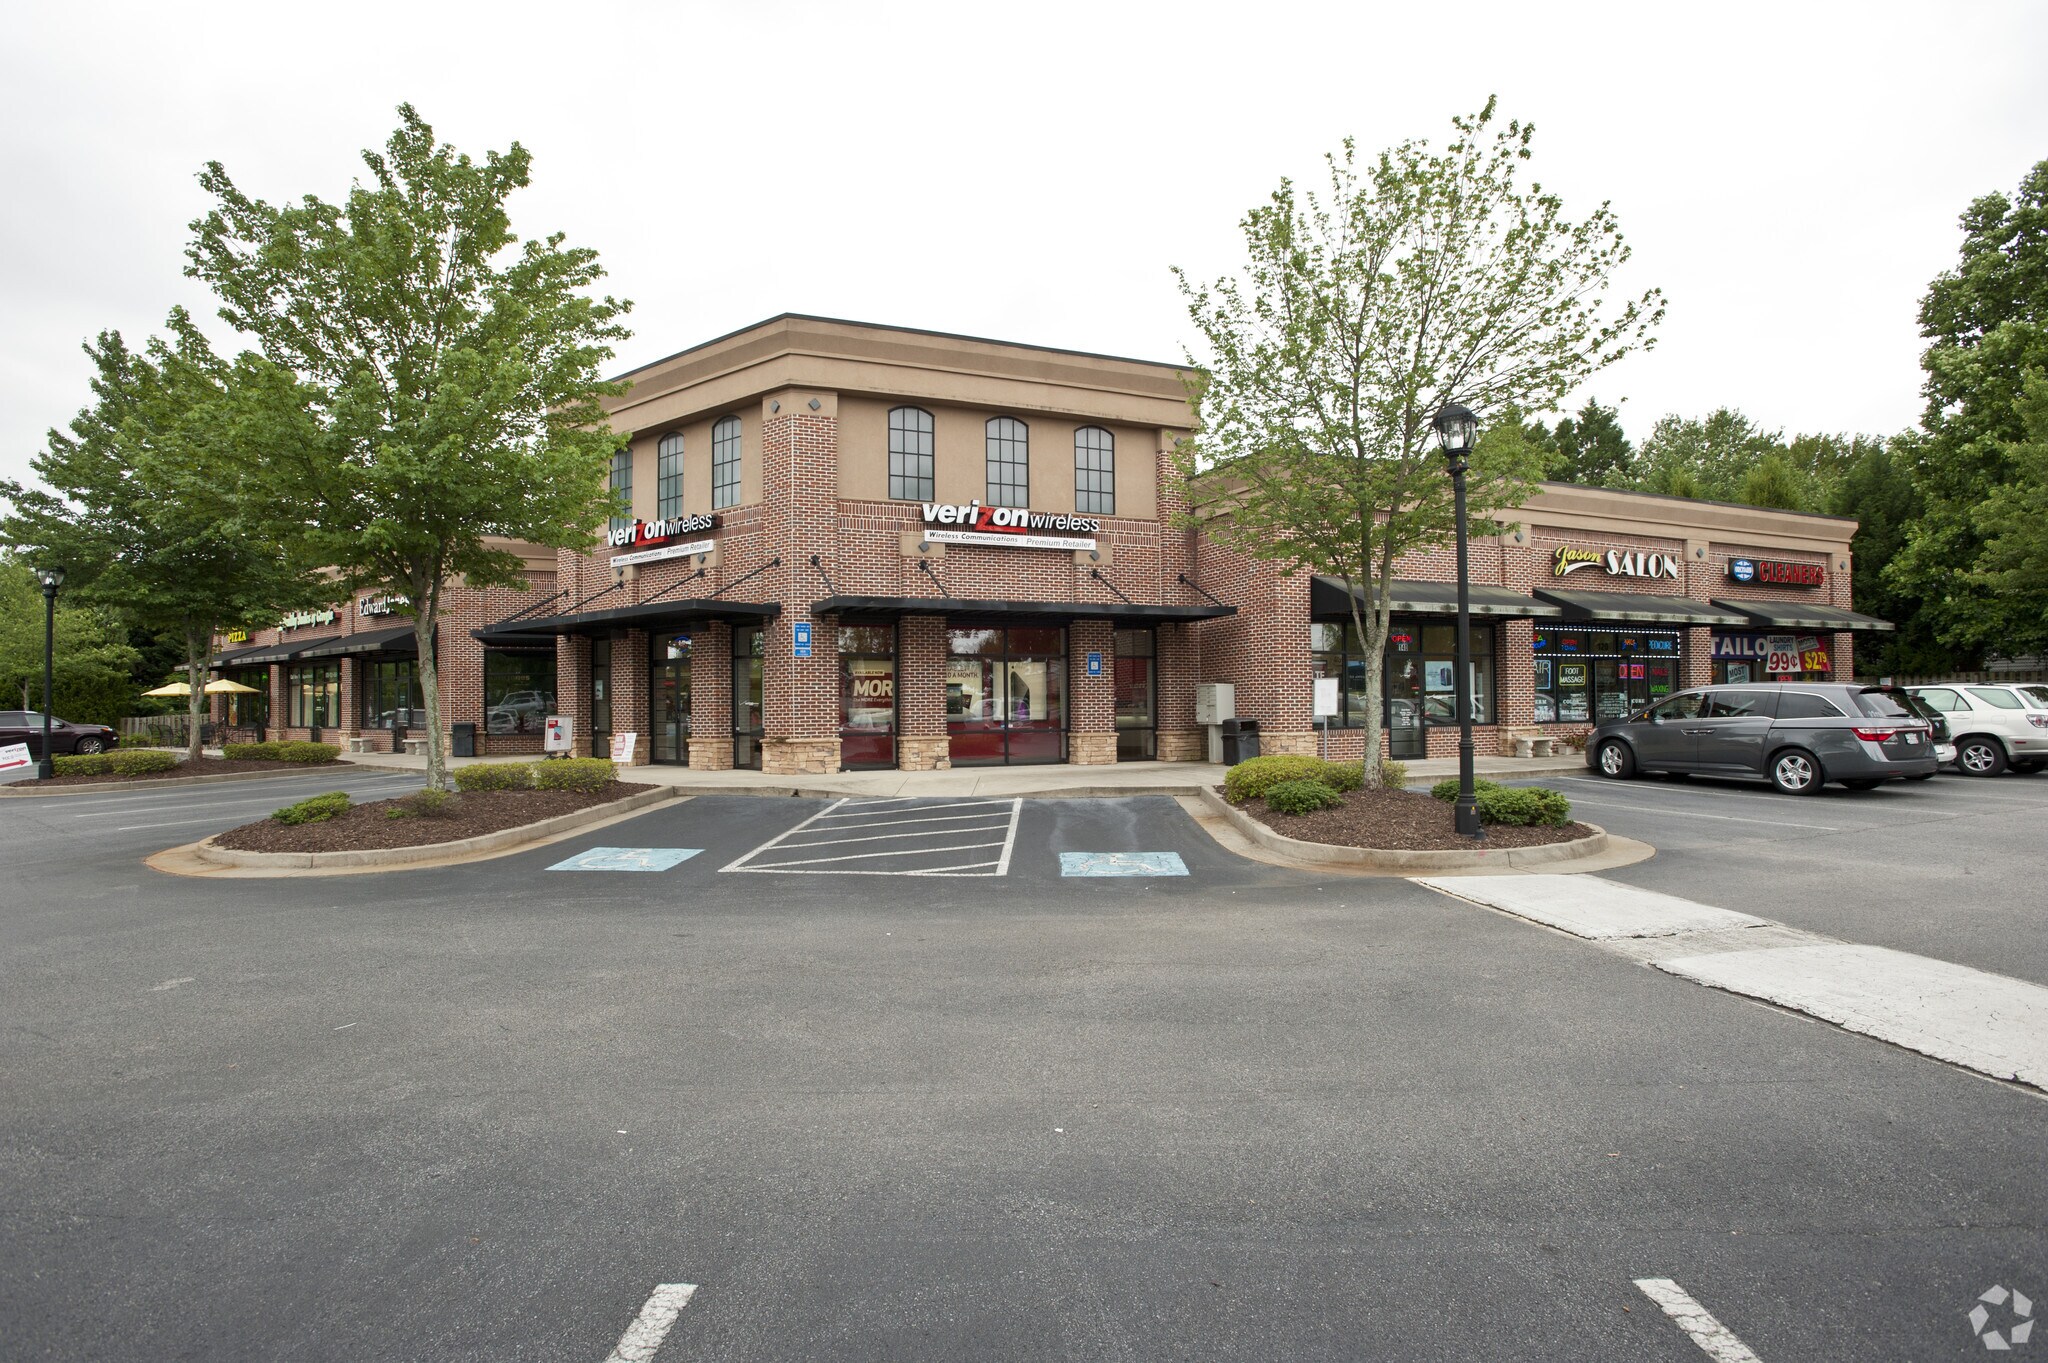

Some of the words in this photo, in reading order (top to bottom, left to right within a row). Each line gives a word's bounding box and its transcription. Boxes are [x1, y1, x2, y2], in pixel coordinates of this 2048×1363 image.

[922, 499, 1028, 533] verizon
[1030, 512, 1100, 533] wireless
[607, 518, 667, 547] verizon
[665, 513, 713, 536] wireless
[928, 530, 959, 540] Wireless
[961, 533, 1019, 543] Communications
[666, 546, 689, 556] Premium
[689, 541, 711, 552] Retailer
[1026, 537, 1061, 548] Premium
[1062, 540, 1092, 549] Retailer
[629, 551, 663, 561] Communications
[1554, 545, 1601, 576] Jason
[1605, 549, 1678, 579] SALON
[1759, 561, 1825, 585] CLEANERS
[360, 594, 387, 616] Edward
[227, 630, 247, 643] PIZZA
[1390, 634, 1413, 643] OPEN
[1769, 636, 1794, 644] LAUNDRY
[1711, 636, 1768, 656] TAILO
[1773, 643, 1794, 652] SHIRTS
[1768, 652, 1799, 671] 99¢
[1564, 667, 1579, 675] FOOT
[1619, 664, 1645, 678] OEN
[1560, 675, 1585, 683] MASSAGE
[853, 679, 893, 697] MOR
